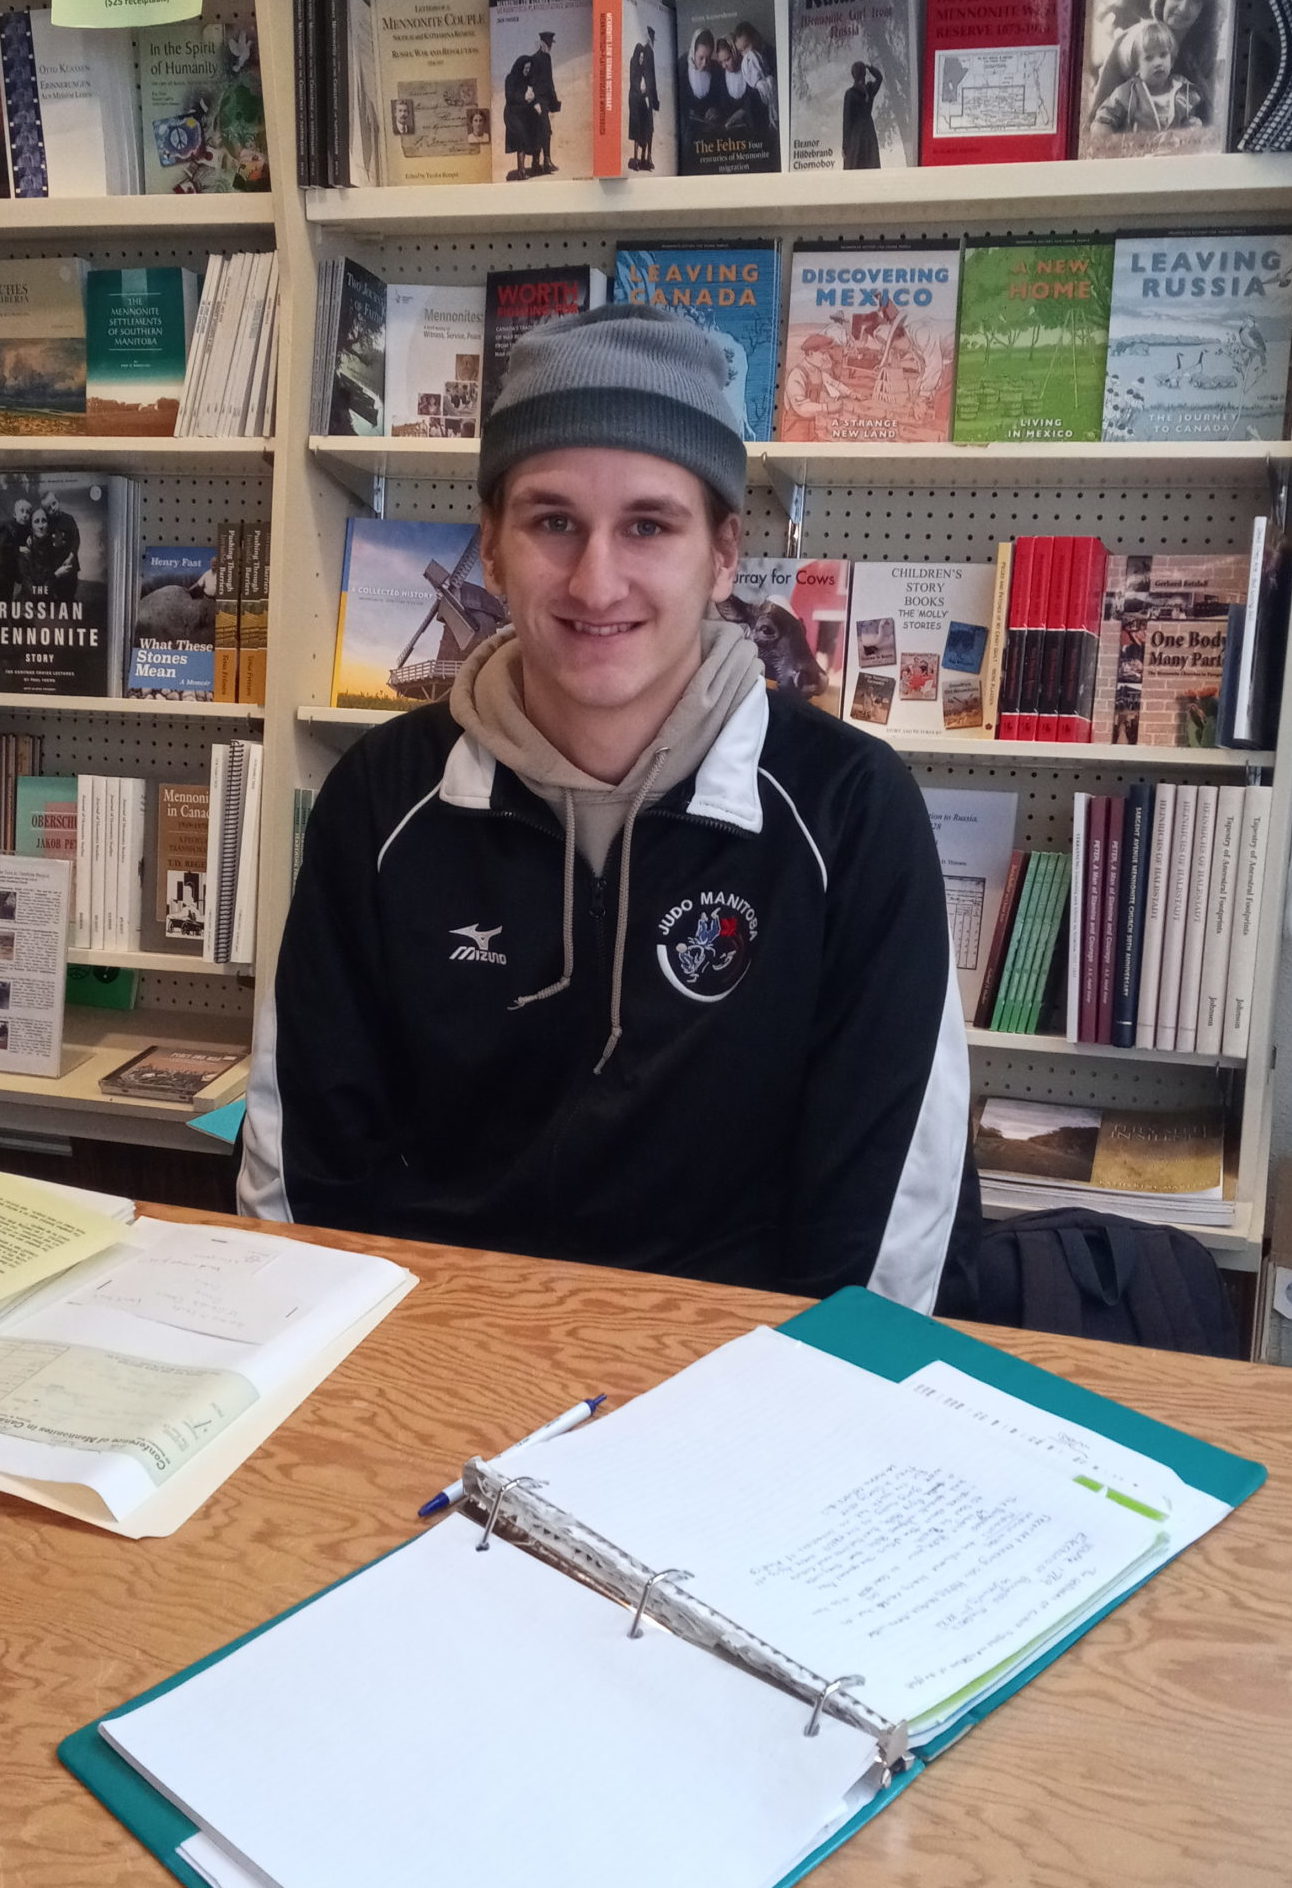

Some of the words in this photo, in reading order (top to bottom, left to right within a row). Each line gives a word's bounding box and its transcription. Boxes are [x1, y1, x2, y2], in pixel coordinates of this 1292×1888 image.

[444, 13, 485, 26] COUPLE
[936, 6, 1017, 20] MENNONITE
[830, 24, 859, 39] Russia
[936, 24, 992, 38] RESERVE
[150, 43, 160, 56] In
[164, 42, 181, 56] the
[185, 41, 216, 59] Spirit
[151, 60, 162, 75] of
[166, 61, 218, 78] Humanity
[695, 140, 714, 154] The
[716, 138, 746, 151] Fehrs
[794, 139, 819, 149] Eleanor
[736, 150, 770, 160] Mennonite
[793, 148, 833, 159] Hildebrand
[1013, 261, 1027, 275] A
[1037, 260, 1090, 274] NEW
[1131, 250, 1281, 273] LEAVING
[630, 264, 759, 282] LEAVING
[802, 268, 949, 284] DISCOVERING
[497, 281, 578, 305] WORTH
[1008, 282, 1091, 300] HOME
[1142, 276, 1266, 298] RUSSIA
[128, 297, 142, 306] THE
[630, 288, 757, 306] CANADA
[816, 288, 933, 307] MEXICO
[111, 307, 160, 316] MENNONITE
[109, 318, 162, 326] SETTLEMENTS
[120, 327, 163, 336] SOUTHERN
[1178, 413, 1237, 422] JOURNEY
[833, 430, 859, 438] NEW
[864, 430, 896, 438] LAND
[151, 557, 179, 568] Henry
[182, 558, 202, 567] Fast
[734, 572, 767, 588] urray
[772, 568, 791, 584] for
[796, 570, 835, 585] Cows
[892, 568, 962, 579] CHILDREN'S
[32, 585, 49, 595] THE
[358, 586, 400, 596] COLLECTED
[906, 582, 945, 592] STORY
[904, 597, 944, 607] BOOKS
[0, 601, 83, 620] RUSSIAN
[0, 627, 98, 646] ENNONITE
[1151, 631, 1185, 647] One
[140, 638, 173, 650] What
[177, 639, 213, 652] These
[25, 654, 55, 663] STORY
[136, 650, 188, 664] Stones
[1149, 652, 1189, 670] Many
[1191, 652, 1224, 667] Part
[135, 664, 177, 678] Mean
[163, 789, 209, 804] Mennoni
[168, 804, 177, 816] in
[1133, 807, 1142, 836] SARGENT
[1156, 799, 1168, 851] HEINRICHS
[1179, 801, 1191, 853] HEINRICHS
[1199, 802, 1211, 854] HEINRICHS
[1222, 815, 1235, 847] Tapestry
[1248, 816, 1261, 848] Tapestry
[36, 838, 61, 848] JAKOB
[1092, 840, 1101, 862] PETER,
[1110, 840, 1119, 862] PETER,
[1131, 838, 1141, 864] AVENUE
[1155, 852, 1164, 864] OF
[1178, 854, 1186, 866] OF
[1198, 855, 1207, 867] OF
[1223, 849, 1232, 858] of
[1250, 850, 1258, 859] of
[185, 859, 207, 868] REGE
[1091, 872, 1099, 885] Man
[1108, 872, 1116, 886] Man
[1128, 865, 1138, 904] MENNONITE
[1220, 859, 1230, 895] Ancestral
[1246, 861, 1256, 896] Ancestral
[1150, 867, 1162, 920] HALBSTADT
[1172, 868, 1185, 922] HALBSTADT
[1193, 870, 1205, 923] HALBSTADT
[658, 899, 693, 935] JUDO
[700, 891, 758, 941] MANITOBA
[1089, 895, 1098, 921] Stamina
[1106, 896, 1116, 921] Stamina
[1216, 896, 1227, 934] Footprints
[1126, 906, 1135, 933] CHURCH
[1242, 898, 1253, 936] Footprints
[1089, 923, 1097, 934] and
[1106, 923, 1114, 935] and
[449, 946, 507, 965] MIZUNO
[1086, 936, 1096, 962] Courage
[1103, 937, 1113, 964] Courage
[1122, 952, 1132, 997] ANNIVERSARY
[1207, 996, 1218, 1027] Johnson
[1234, 998, 1245, 1030] Johnson
[0, 1417, 24, 1428] Cana
[39, 1427, 97, 1443] Mennonites
[112, 1437, 166, 1471] Conference
